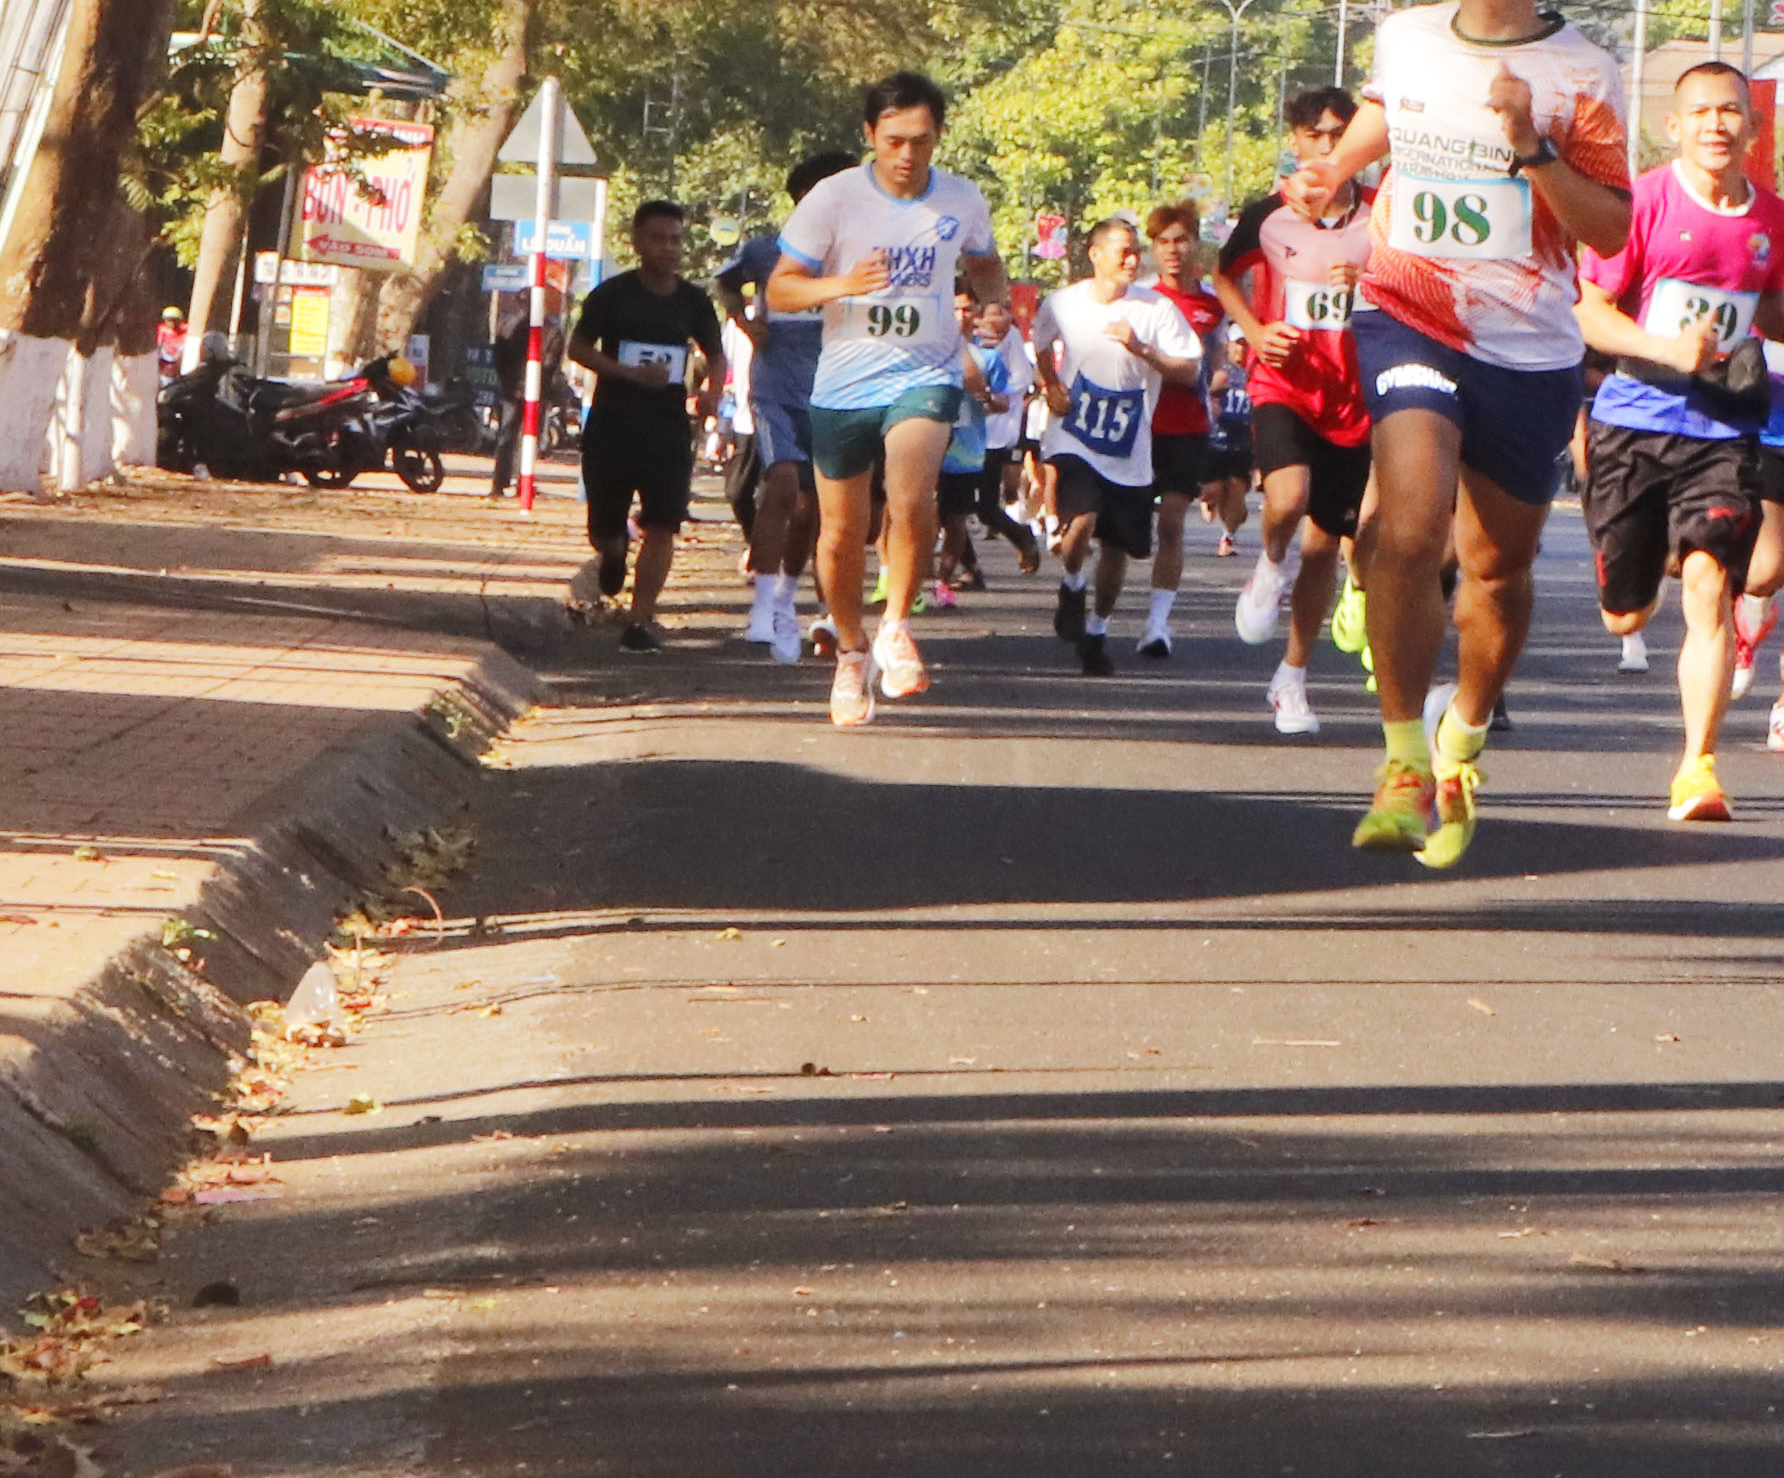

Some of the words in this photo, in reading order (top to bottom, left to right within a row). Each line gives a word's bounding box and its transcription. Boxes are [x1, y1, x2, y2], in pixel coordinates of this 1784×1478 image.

[1413, 191, 1490, 246] 98
[867, 305, 920, 337] 99
[1307, 291, 1353, 321] 69
[1074, 392, 1133, 443] 115
